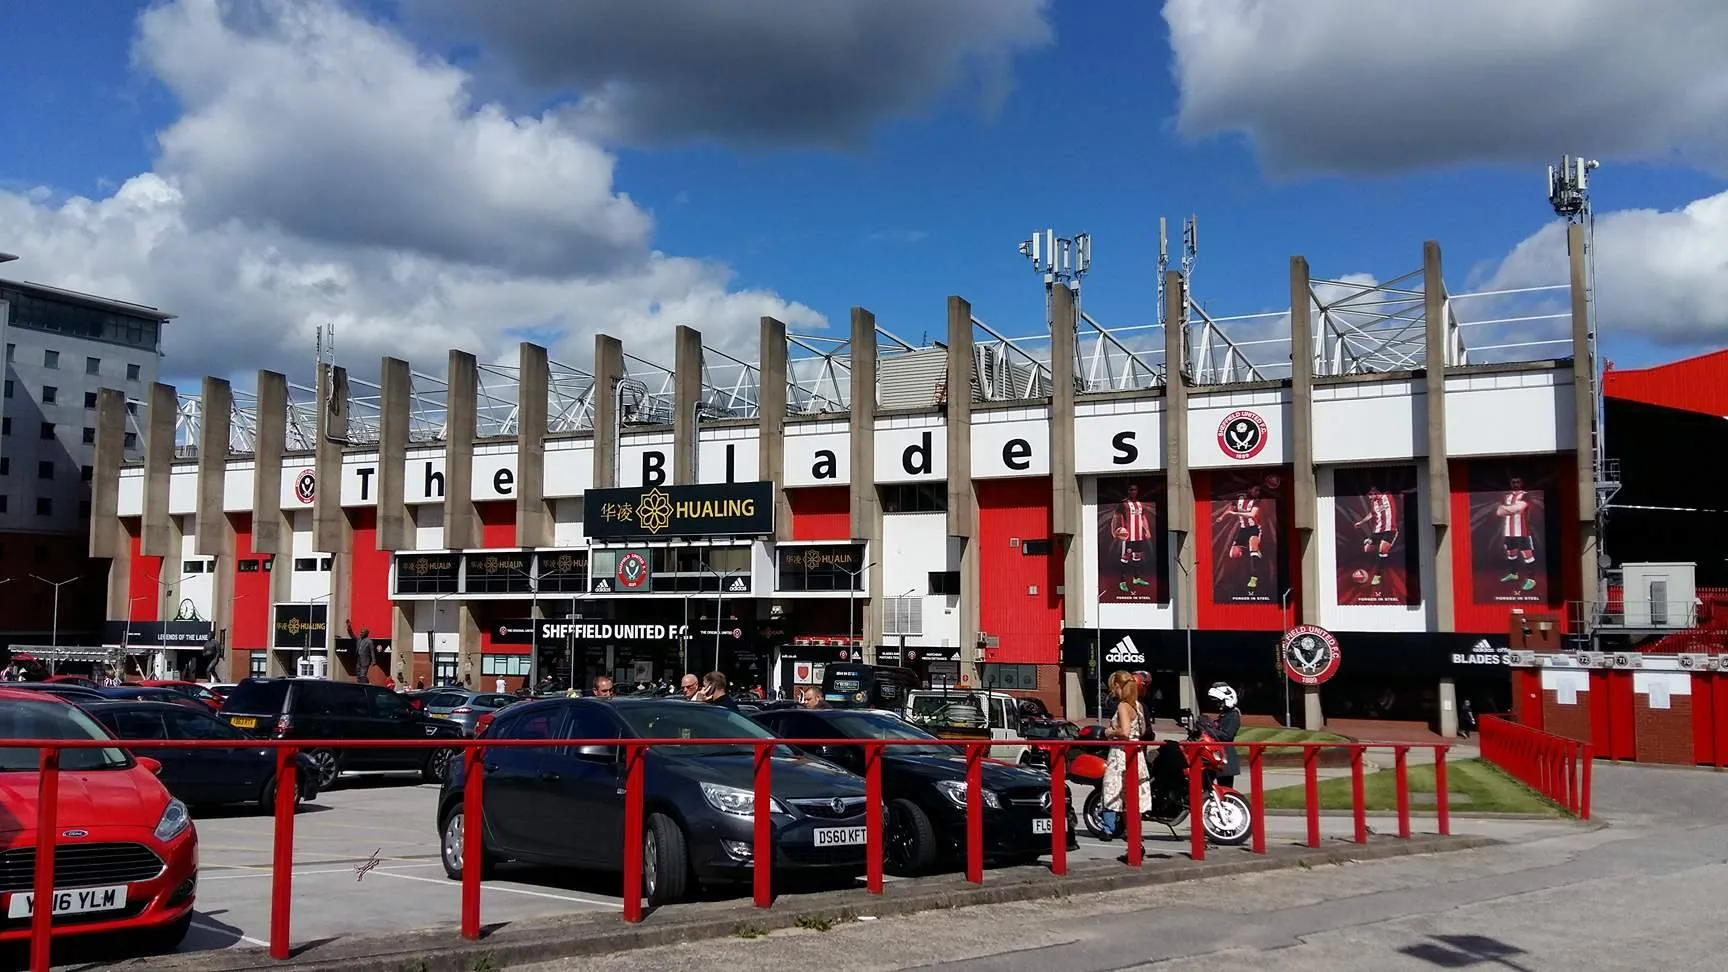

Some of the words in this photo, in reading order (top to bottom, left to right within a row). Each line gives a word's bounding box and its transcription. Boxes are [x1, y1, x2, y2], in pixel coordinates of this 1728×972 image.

[676, 499, 755, 518] HUALING
[614, 625, 665, 639] UNITED
[1105, 651, 1145, 663] adidas
[1453, 654, 1499, 664] BLADES
[1036, 820, 1052, 831] FL6
[819, 830, 847, 844] DS60
[848, 828, 866, 842] KFT
[26, 894, 72, 914] Y16
[79, 889, 116, 909] YLM
